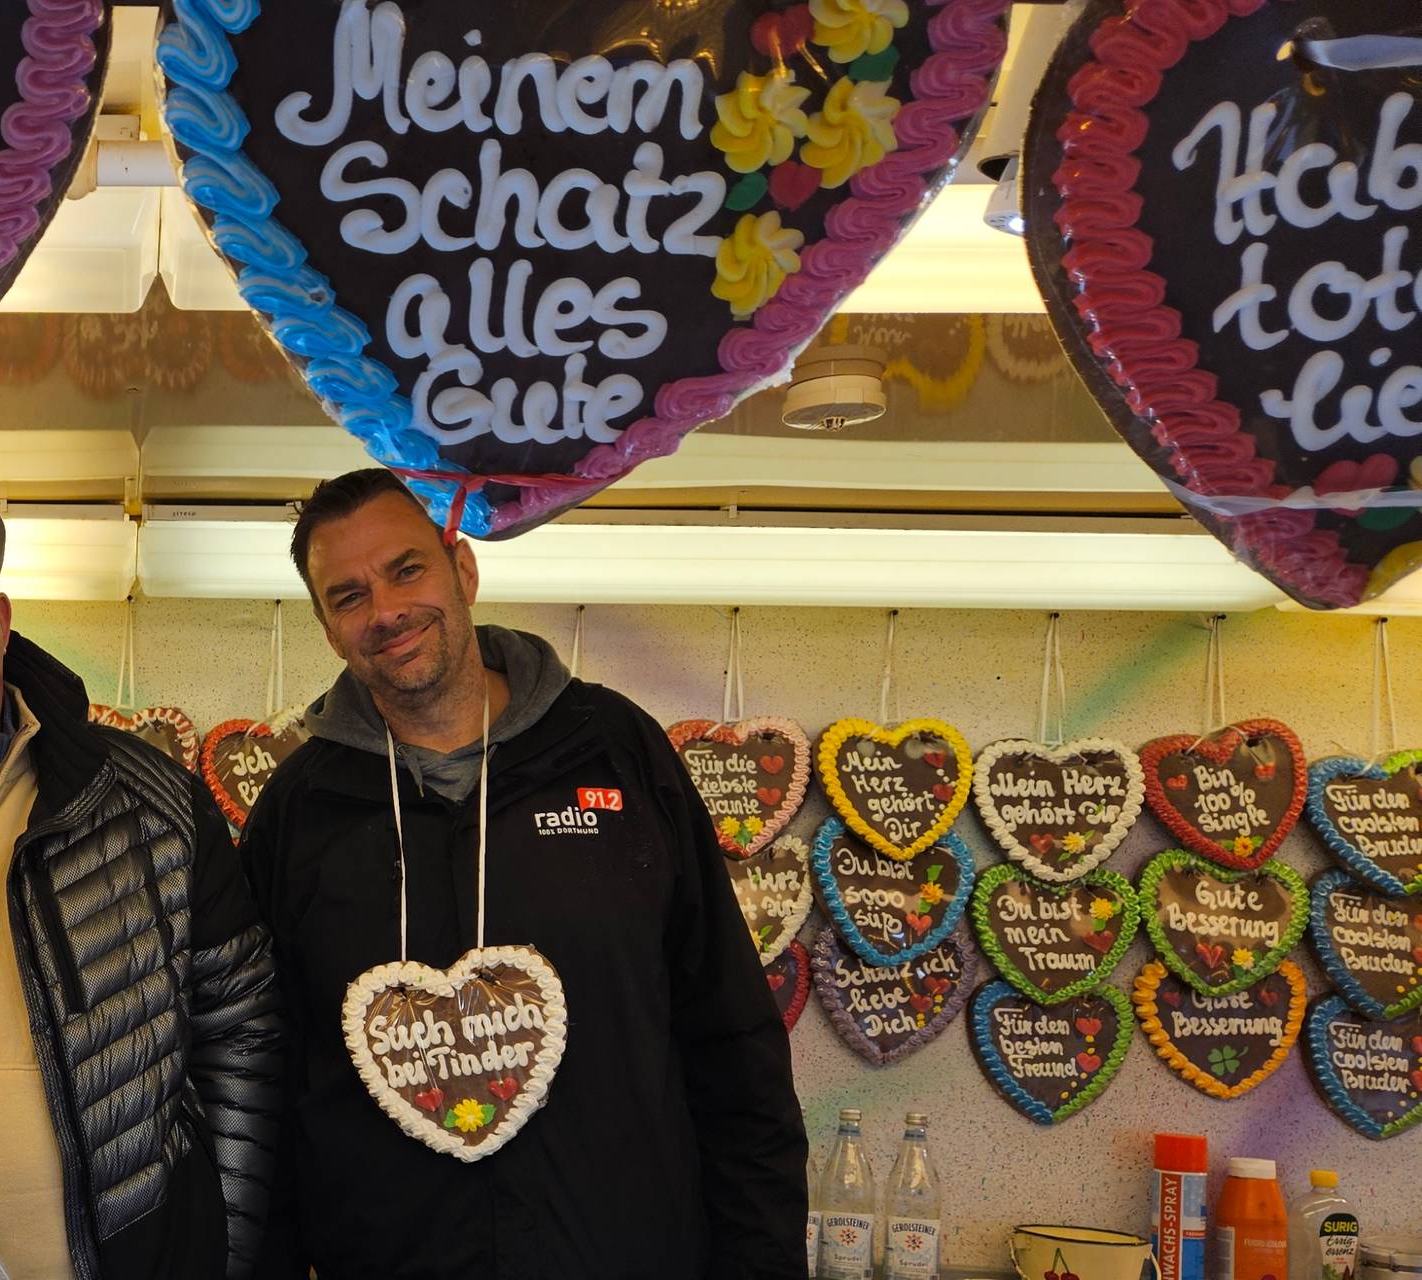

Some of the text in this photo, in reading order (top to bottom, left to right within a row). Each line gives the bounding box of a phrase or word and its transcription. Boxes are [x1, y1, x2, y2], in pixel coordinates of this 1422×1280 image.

[275, 0, 704, 145] Meinem
[320, 138, 727, 254] Schatz
[1213, 226, 1422, 350] tot
[386, 258, 667, 360] alles
[412, 344, 643, 444] Gute
[229, 745, 277, 776] Ich
[684, 749, 757, 776] Für die
[841, 750, 903, 772] Mein
[851, 774, 908, 794] Herz
[990, 769, 1126, 798] Mein Herz
[1193, 765, 1236, 792] Bin
[585, 791, 619, 810] 91.2
[867, 790, 935, 821] gehört
[1194, 781, 1256, 813] 100%
[1326, 784, 1411, 812] Für den
[534, 806, 598, 828] radio
[884, 817, 922, 841] Dir
[1001, 798, 1121, 832] gehört Dir
[557, 827, 599, 835] DORTMUND
[836, 848, 914, 880] Du bist
[746, 866, 801, 893] Herz
[996, 895, 1083, 921] Du bist
[1195, 880, 1264, 912] Gute
[1329, 892, 1409, 927] Für den
[854, 905, 903, 942] süß
[1003, 923, 1071, 945] mein
[1166, 902, 1279, 948] Besserung
[1018, 946, 1096, 971] Traum
[1340, 947, 1416, 975] Bruder
[846, 987, 911, 1013] liebe
[1191, 990, 1254, 1012] Gute
[369, 992, 545, 1055] Such mich
[864, 1009, 919, 1037] Dich
[993, 1007, 1070, 1036] Für den
[1171, 1011, 1283, 1047] Besserung
[999, 1034, 1064, 1056] besten
[1329, 1021, 1404, 1052] Für den
[381, 1040, 535, 1089] bei Tinder
[1008, 1054, 1079, 1078] Freund
[1341, 1069, 1412, 1094] Bruder
[827, 1216, 870, 1231] GEROLSTEINER
[891, 1222, 936, 1237] GEROLSTEINER
[1163, 1177, 1179, 1280] WACHS-SPRAY
[1324, 1221, 1358, 1233] SURIG
